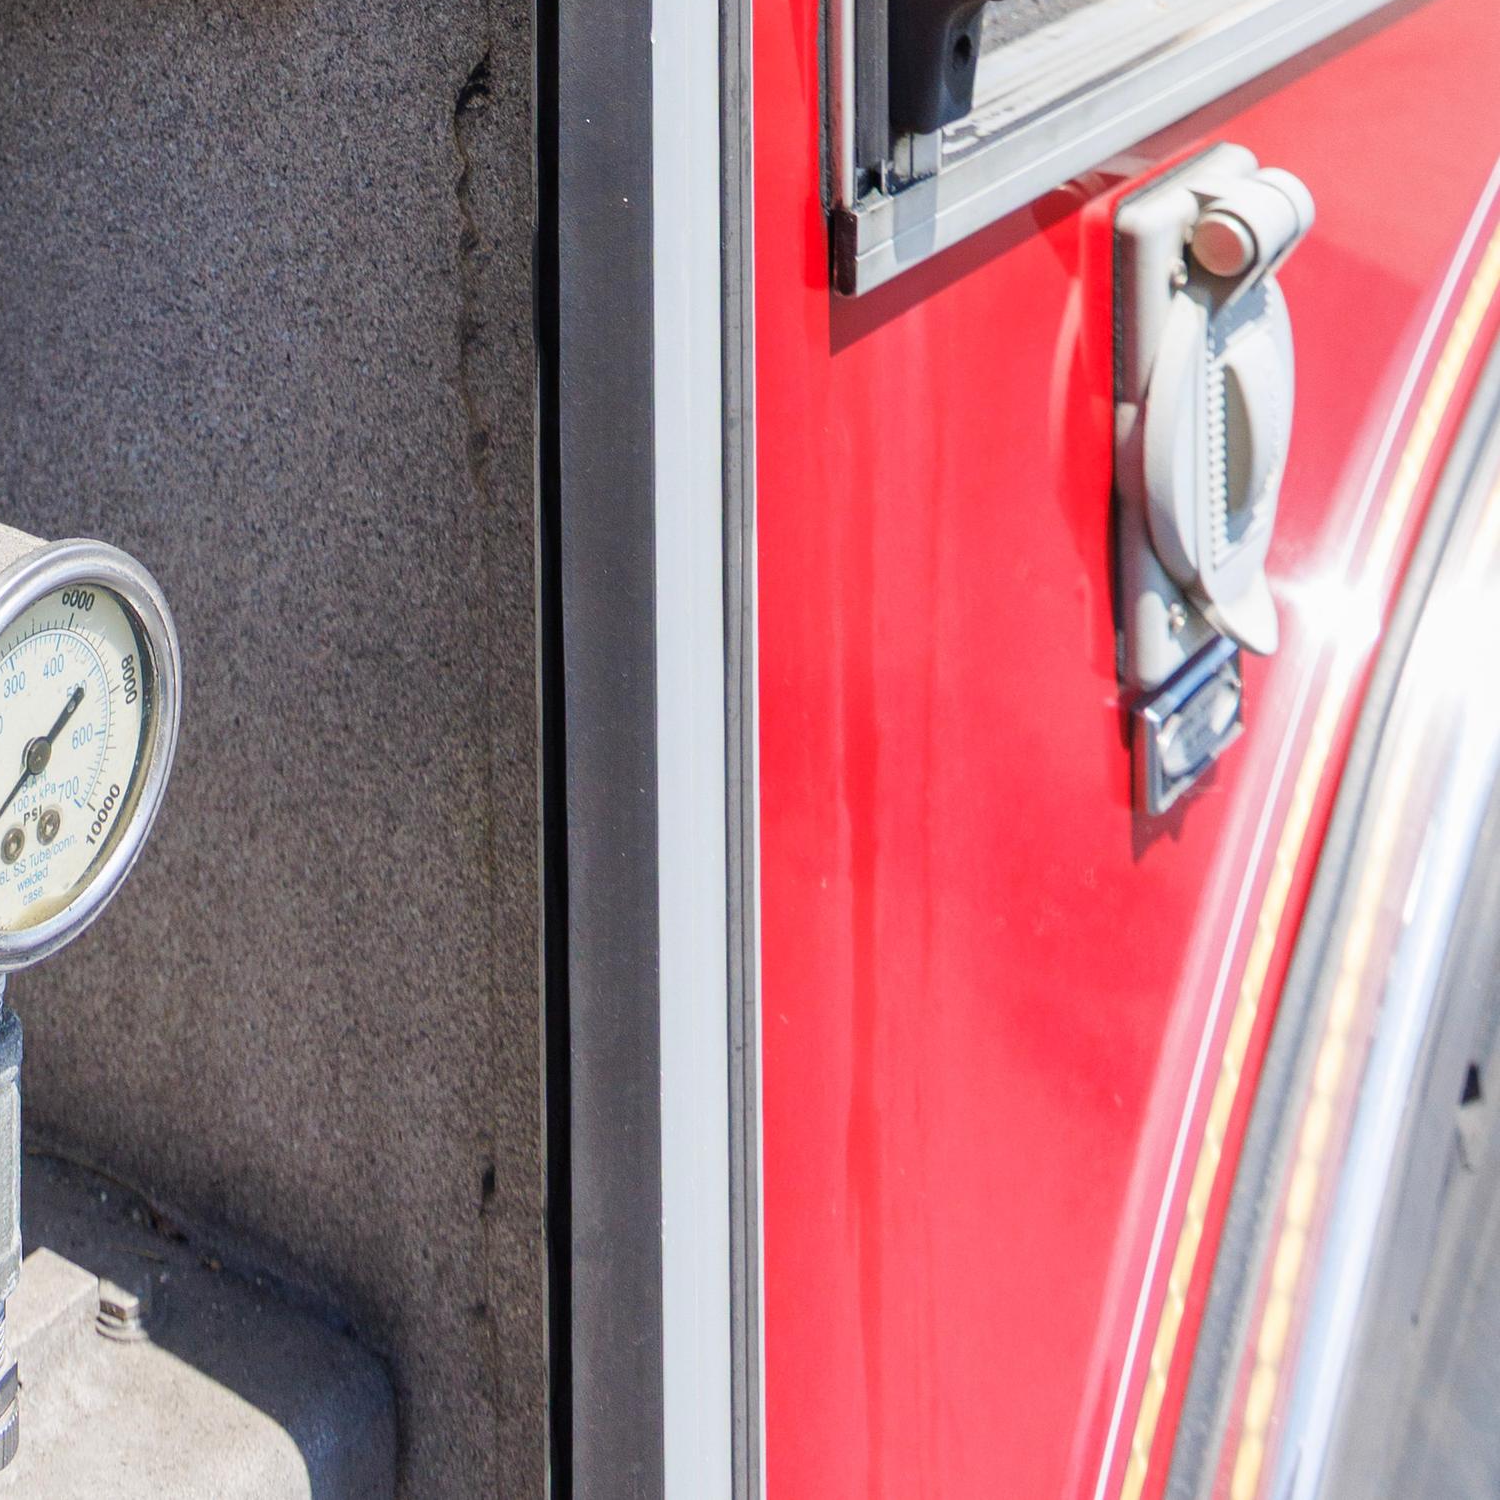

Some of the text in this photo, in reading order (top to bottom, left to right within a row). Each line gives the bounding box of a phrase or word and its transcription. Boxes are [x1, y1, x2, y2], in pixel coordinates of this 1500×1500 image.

[61, 589, 96, 612] 6000
[42, 653, 65, 680] 400
[120, 653, 138, 706] 8000
[2, 670, 27, 699] 300
[71, 722, 94, 750] 600
[39, 781, 57, 799] kPa
[57, 775, 81, 802] 700
[22, 804, 44, 827] PSI
[85, 783, 122, 847] 10000
[12, 861, 28, 878] SS
